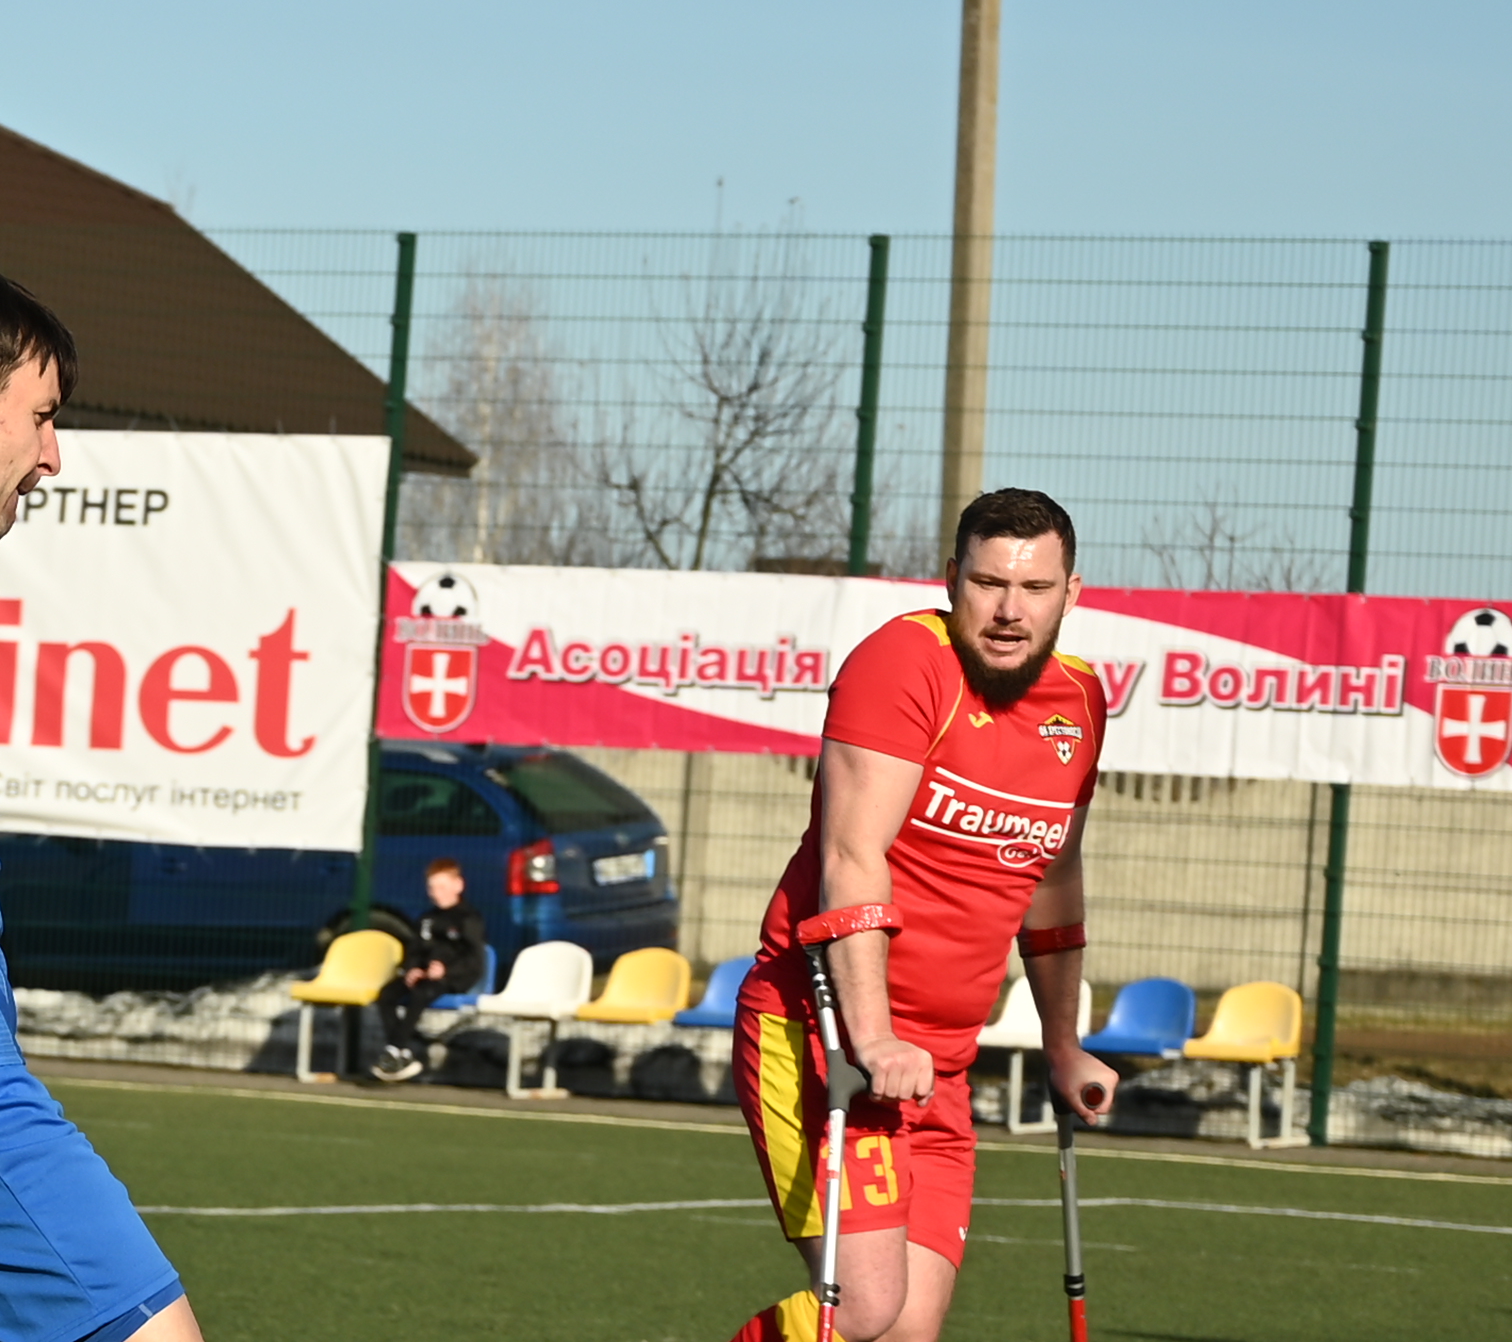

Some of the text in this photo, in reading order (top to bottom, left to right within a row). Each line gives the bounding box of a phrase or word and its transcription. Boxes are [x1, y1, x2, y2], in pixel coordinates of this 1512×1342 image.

[17, 486, 170, 526] РТНЕР
[508, 626, 829, 699] Асоціація
[1159, 646, 1406, 715] Волині
[55, 779, 161, 811] послуг
[171, 780, 305, 814] інтернет
[924, 780, 1072, 850] Traumeel
